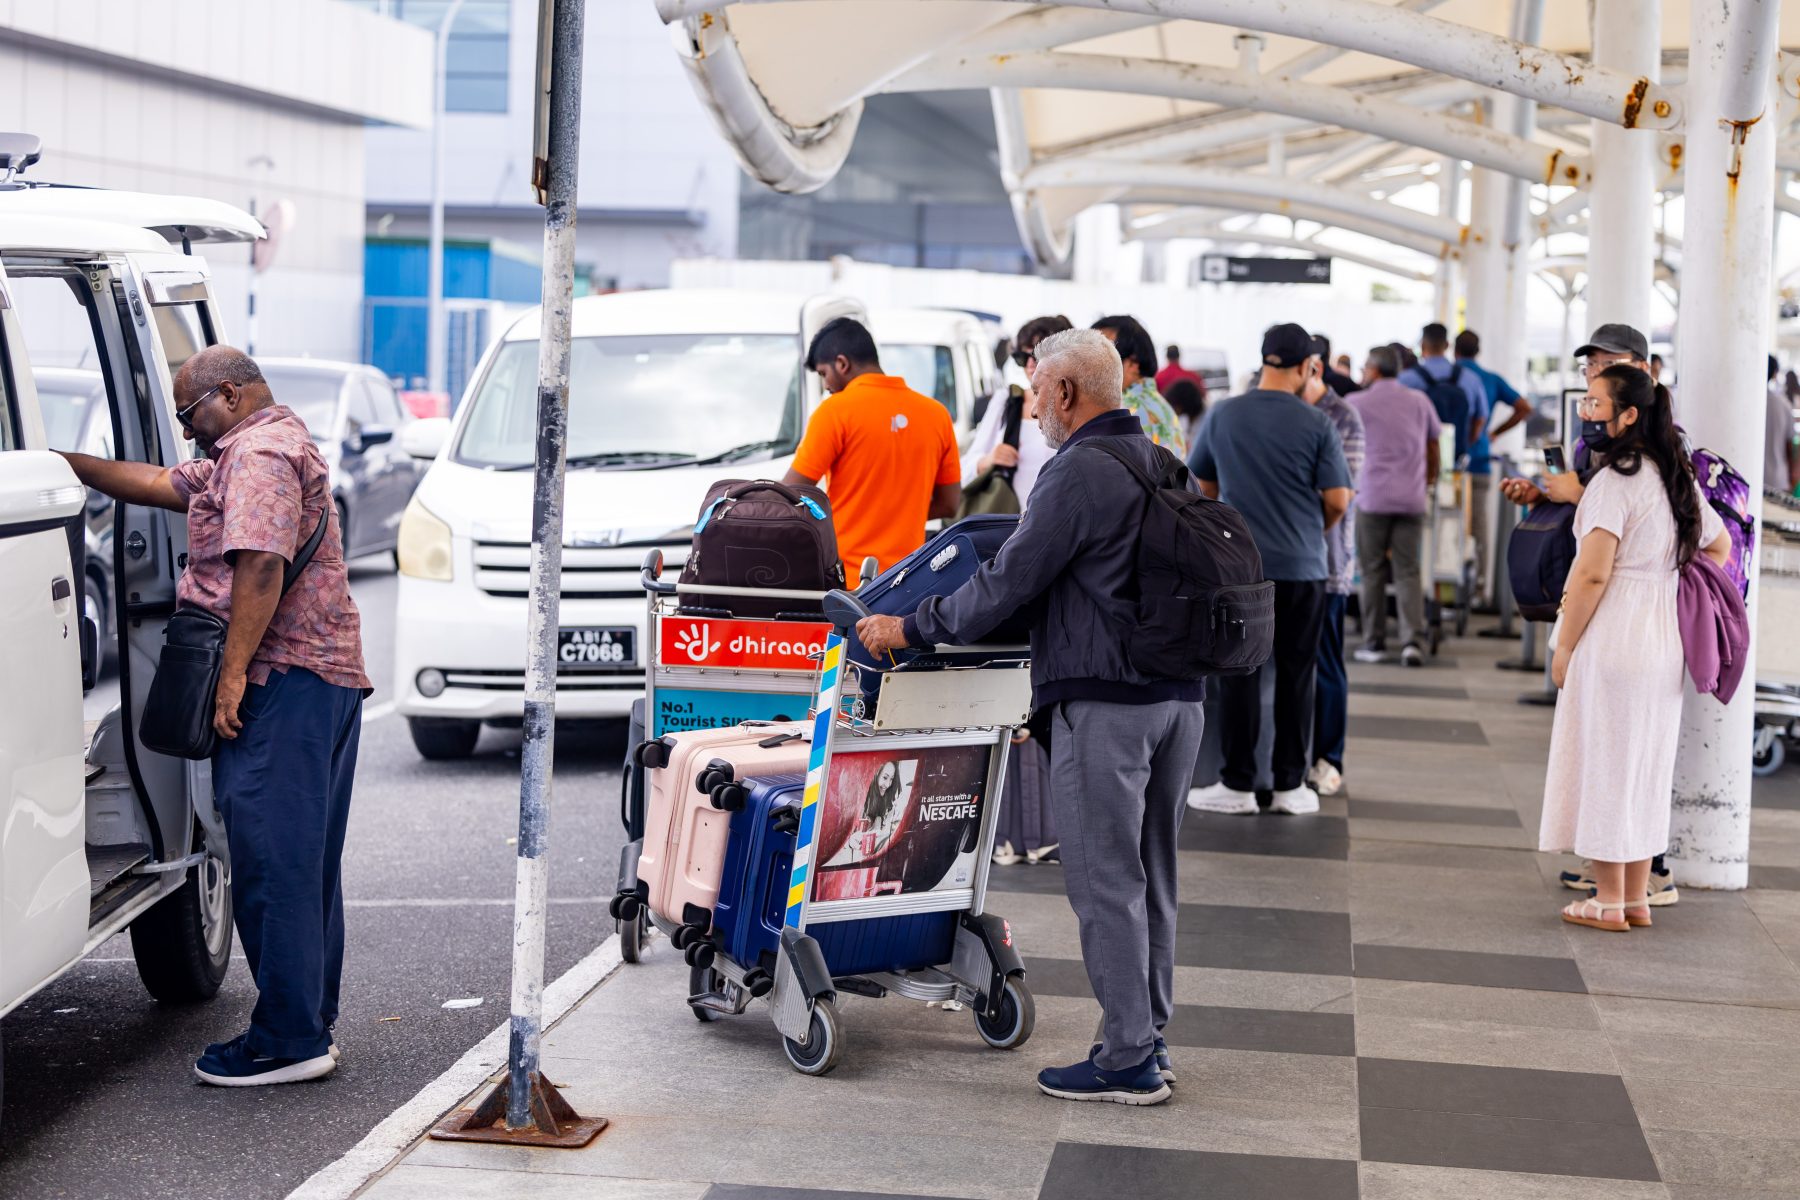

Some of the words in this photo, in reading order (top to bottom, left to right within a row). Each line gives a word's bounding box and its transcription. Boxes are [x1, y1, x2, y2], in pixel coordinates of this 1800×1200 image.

[560, 643, 624, 662] C7068
[661, 701, 693, 713] No.1
[661, 714, 716, 727] Tourist
[936, 794, 953, 802] starts
[954, 793, 966, 801] with
